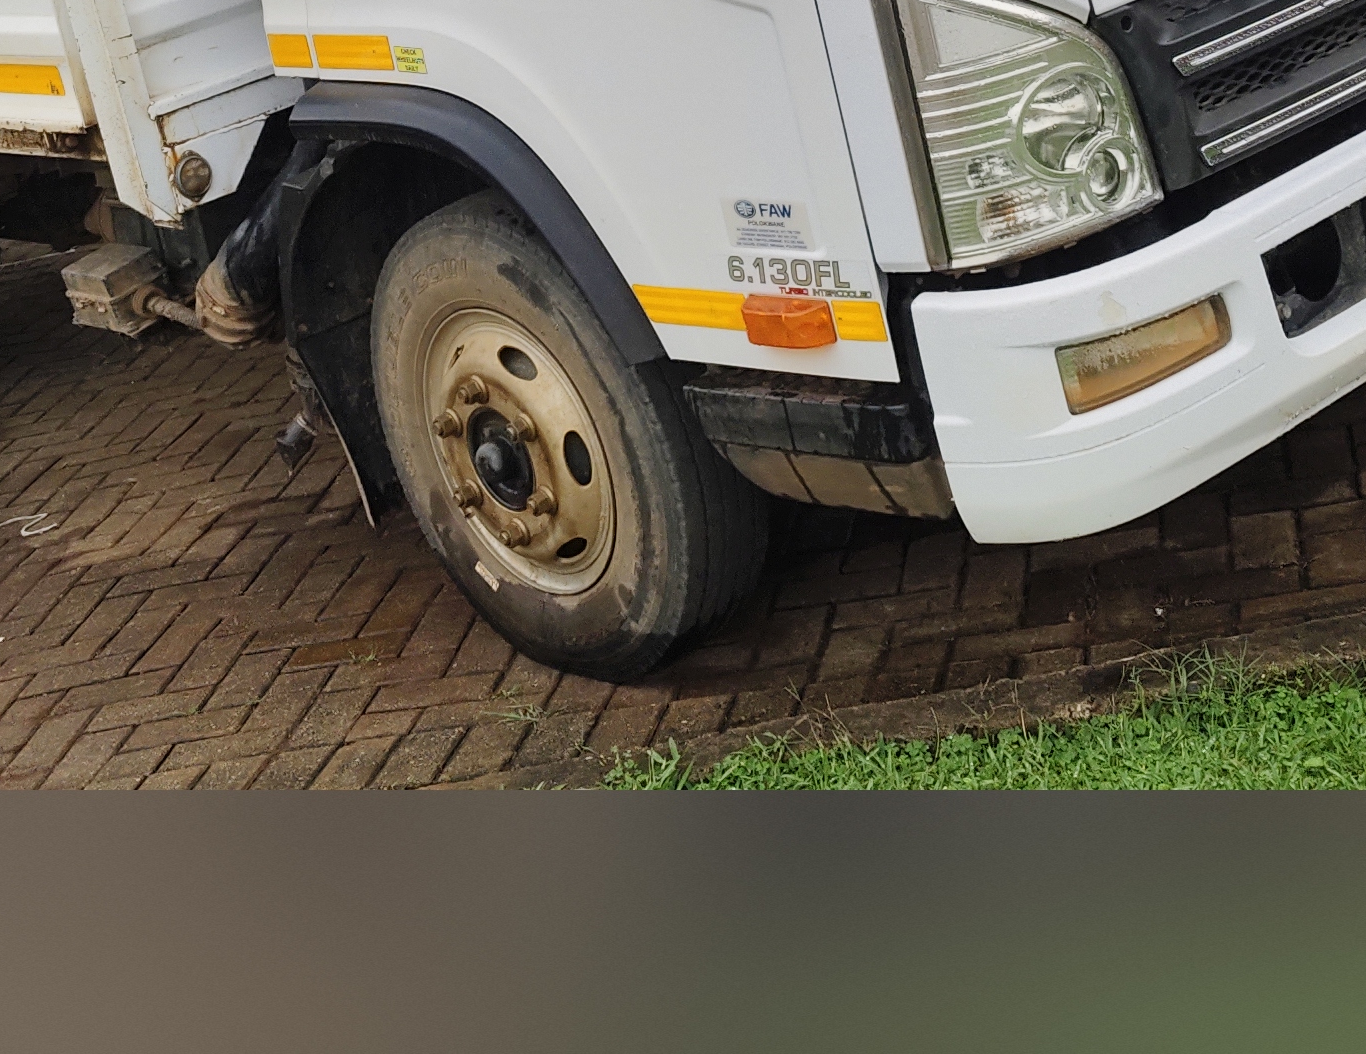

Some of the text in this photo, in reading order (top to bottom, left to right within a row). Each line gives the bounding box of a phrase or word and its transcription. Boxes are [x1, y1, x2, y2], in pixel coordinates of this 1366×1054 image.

[758, 203, 792, 219] FAW
[727, 255, 851, 289] 6.130FL
[778, 286, 872, 299] TURBO INTERCOOLED
